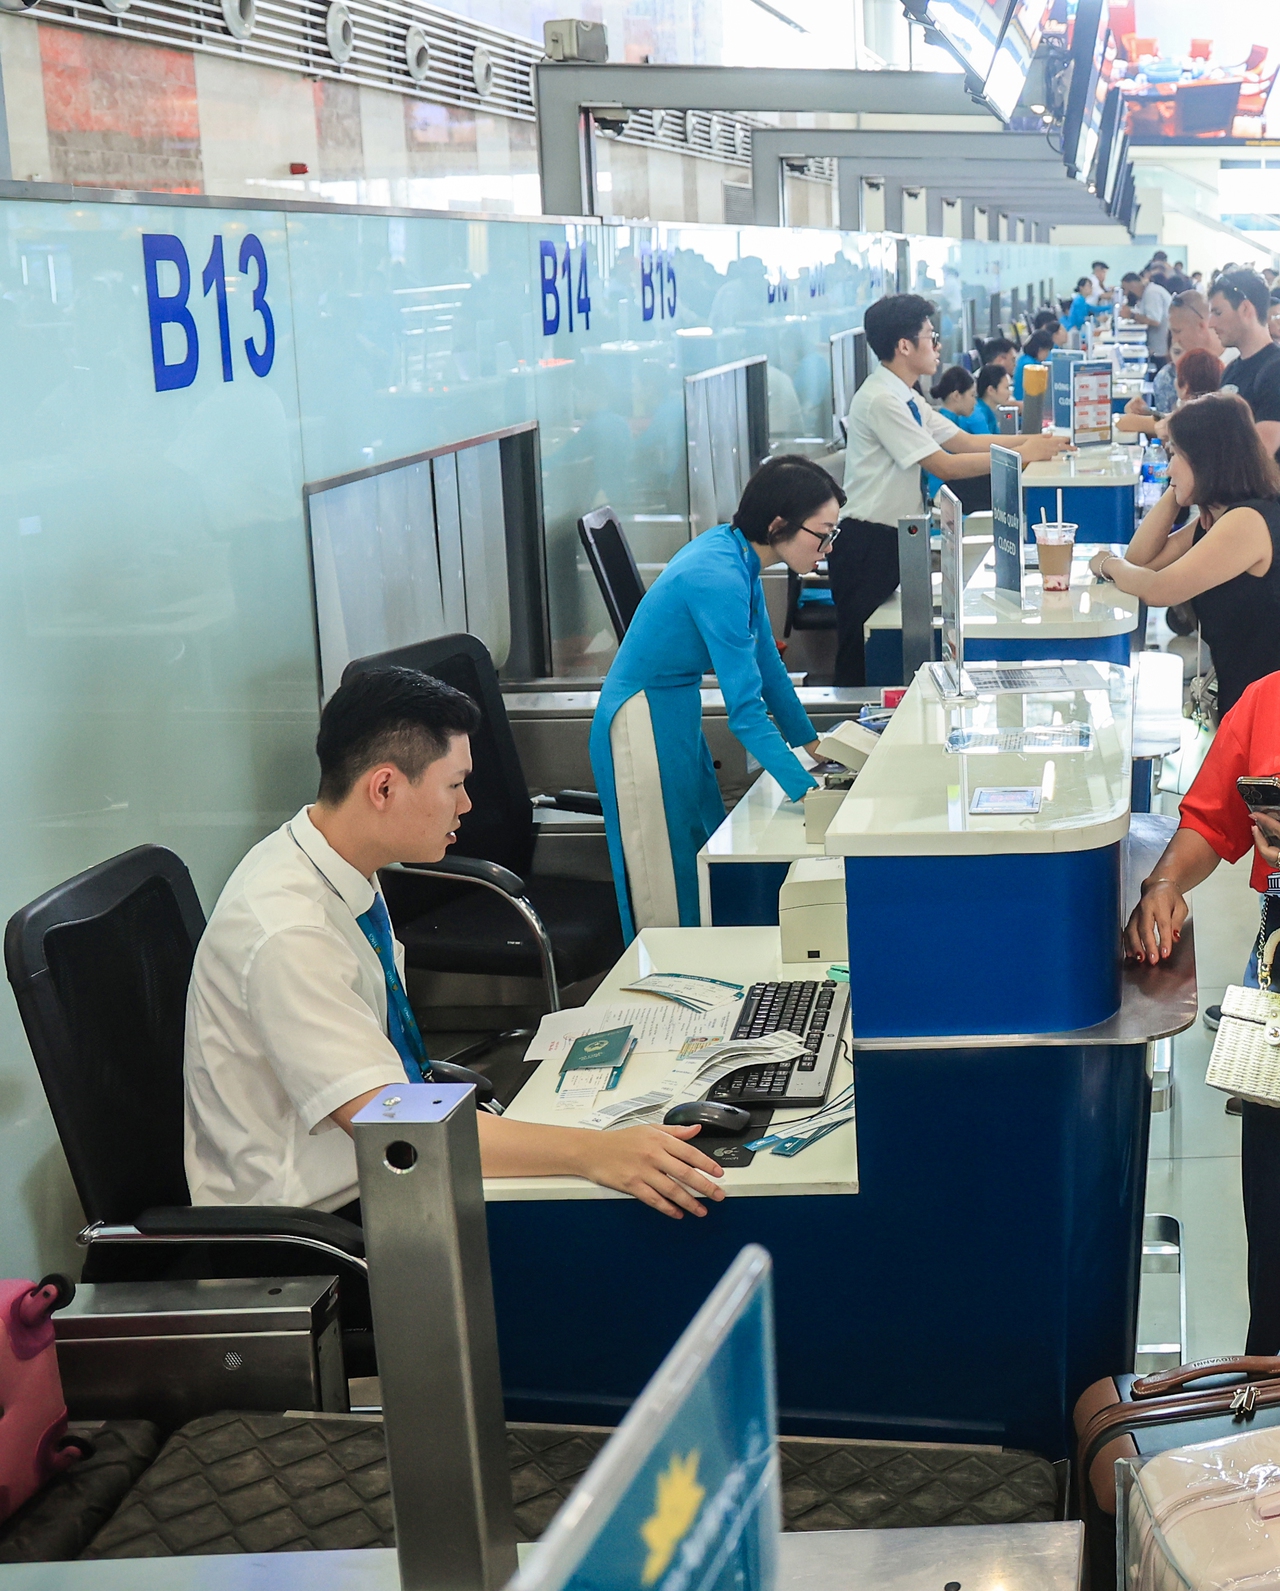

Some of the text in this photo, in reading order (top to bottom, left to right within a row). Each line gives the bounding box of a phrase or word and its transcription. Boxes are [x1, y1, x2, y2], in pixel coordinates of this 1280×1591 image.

[142, 233, 276, 393] B13
[540, 240, 591, 336] B14
[641, 241, 677, 322] B15
[998, 536, 1016, 556] CLOSED
